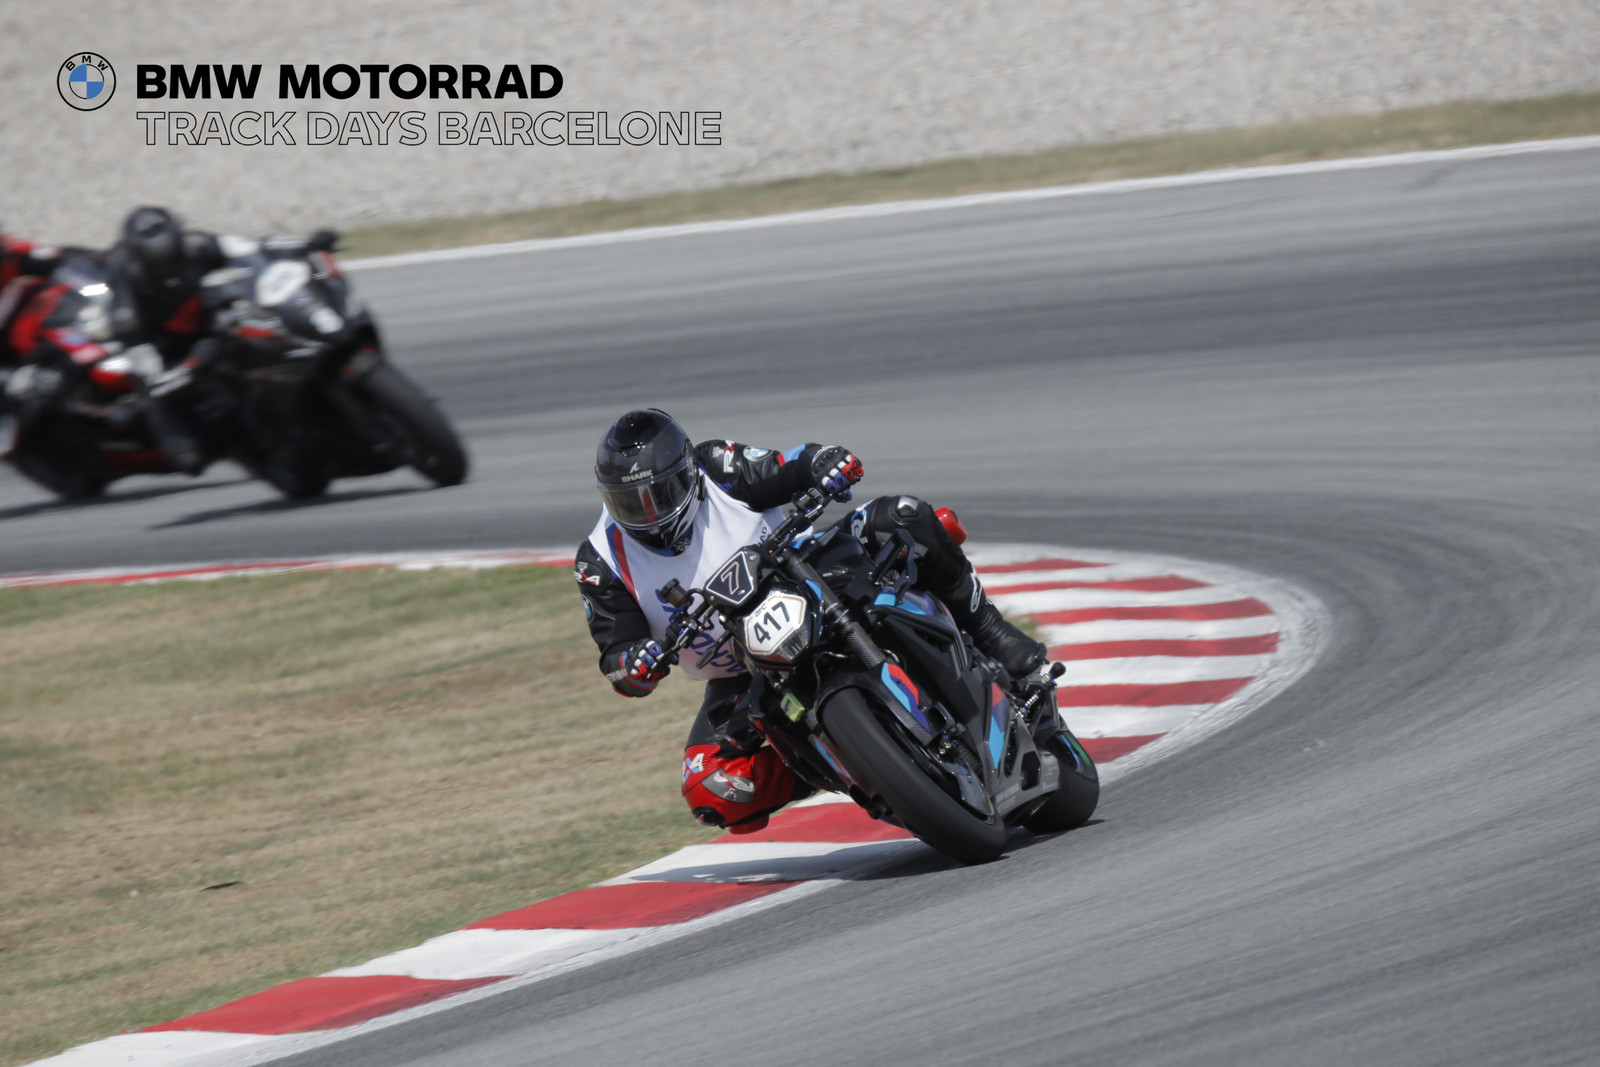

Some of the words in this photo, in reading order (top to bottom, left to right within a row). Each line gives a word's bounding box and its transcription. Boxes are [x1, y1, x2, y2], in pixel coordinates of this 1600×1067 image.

[620, 469, 653, 483] SHARK
[720, 561, 740, 595] 7
[754, 601, 790, 644] 417
